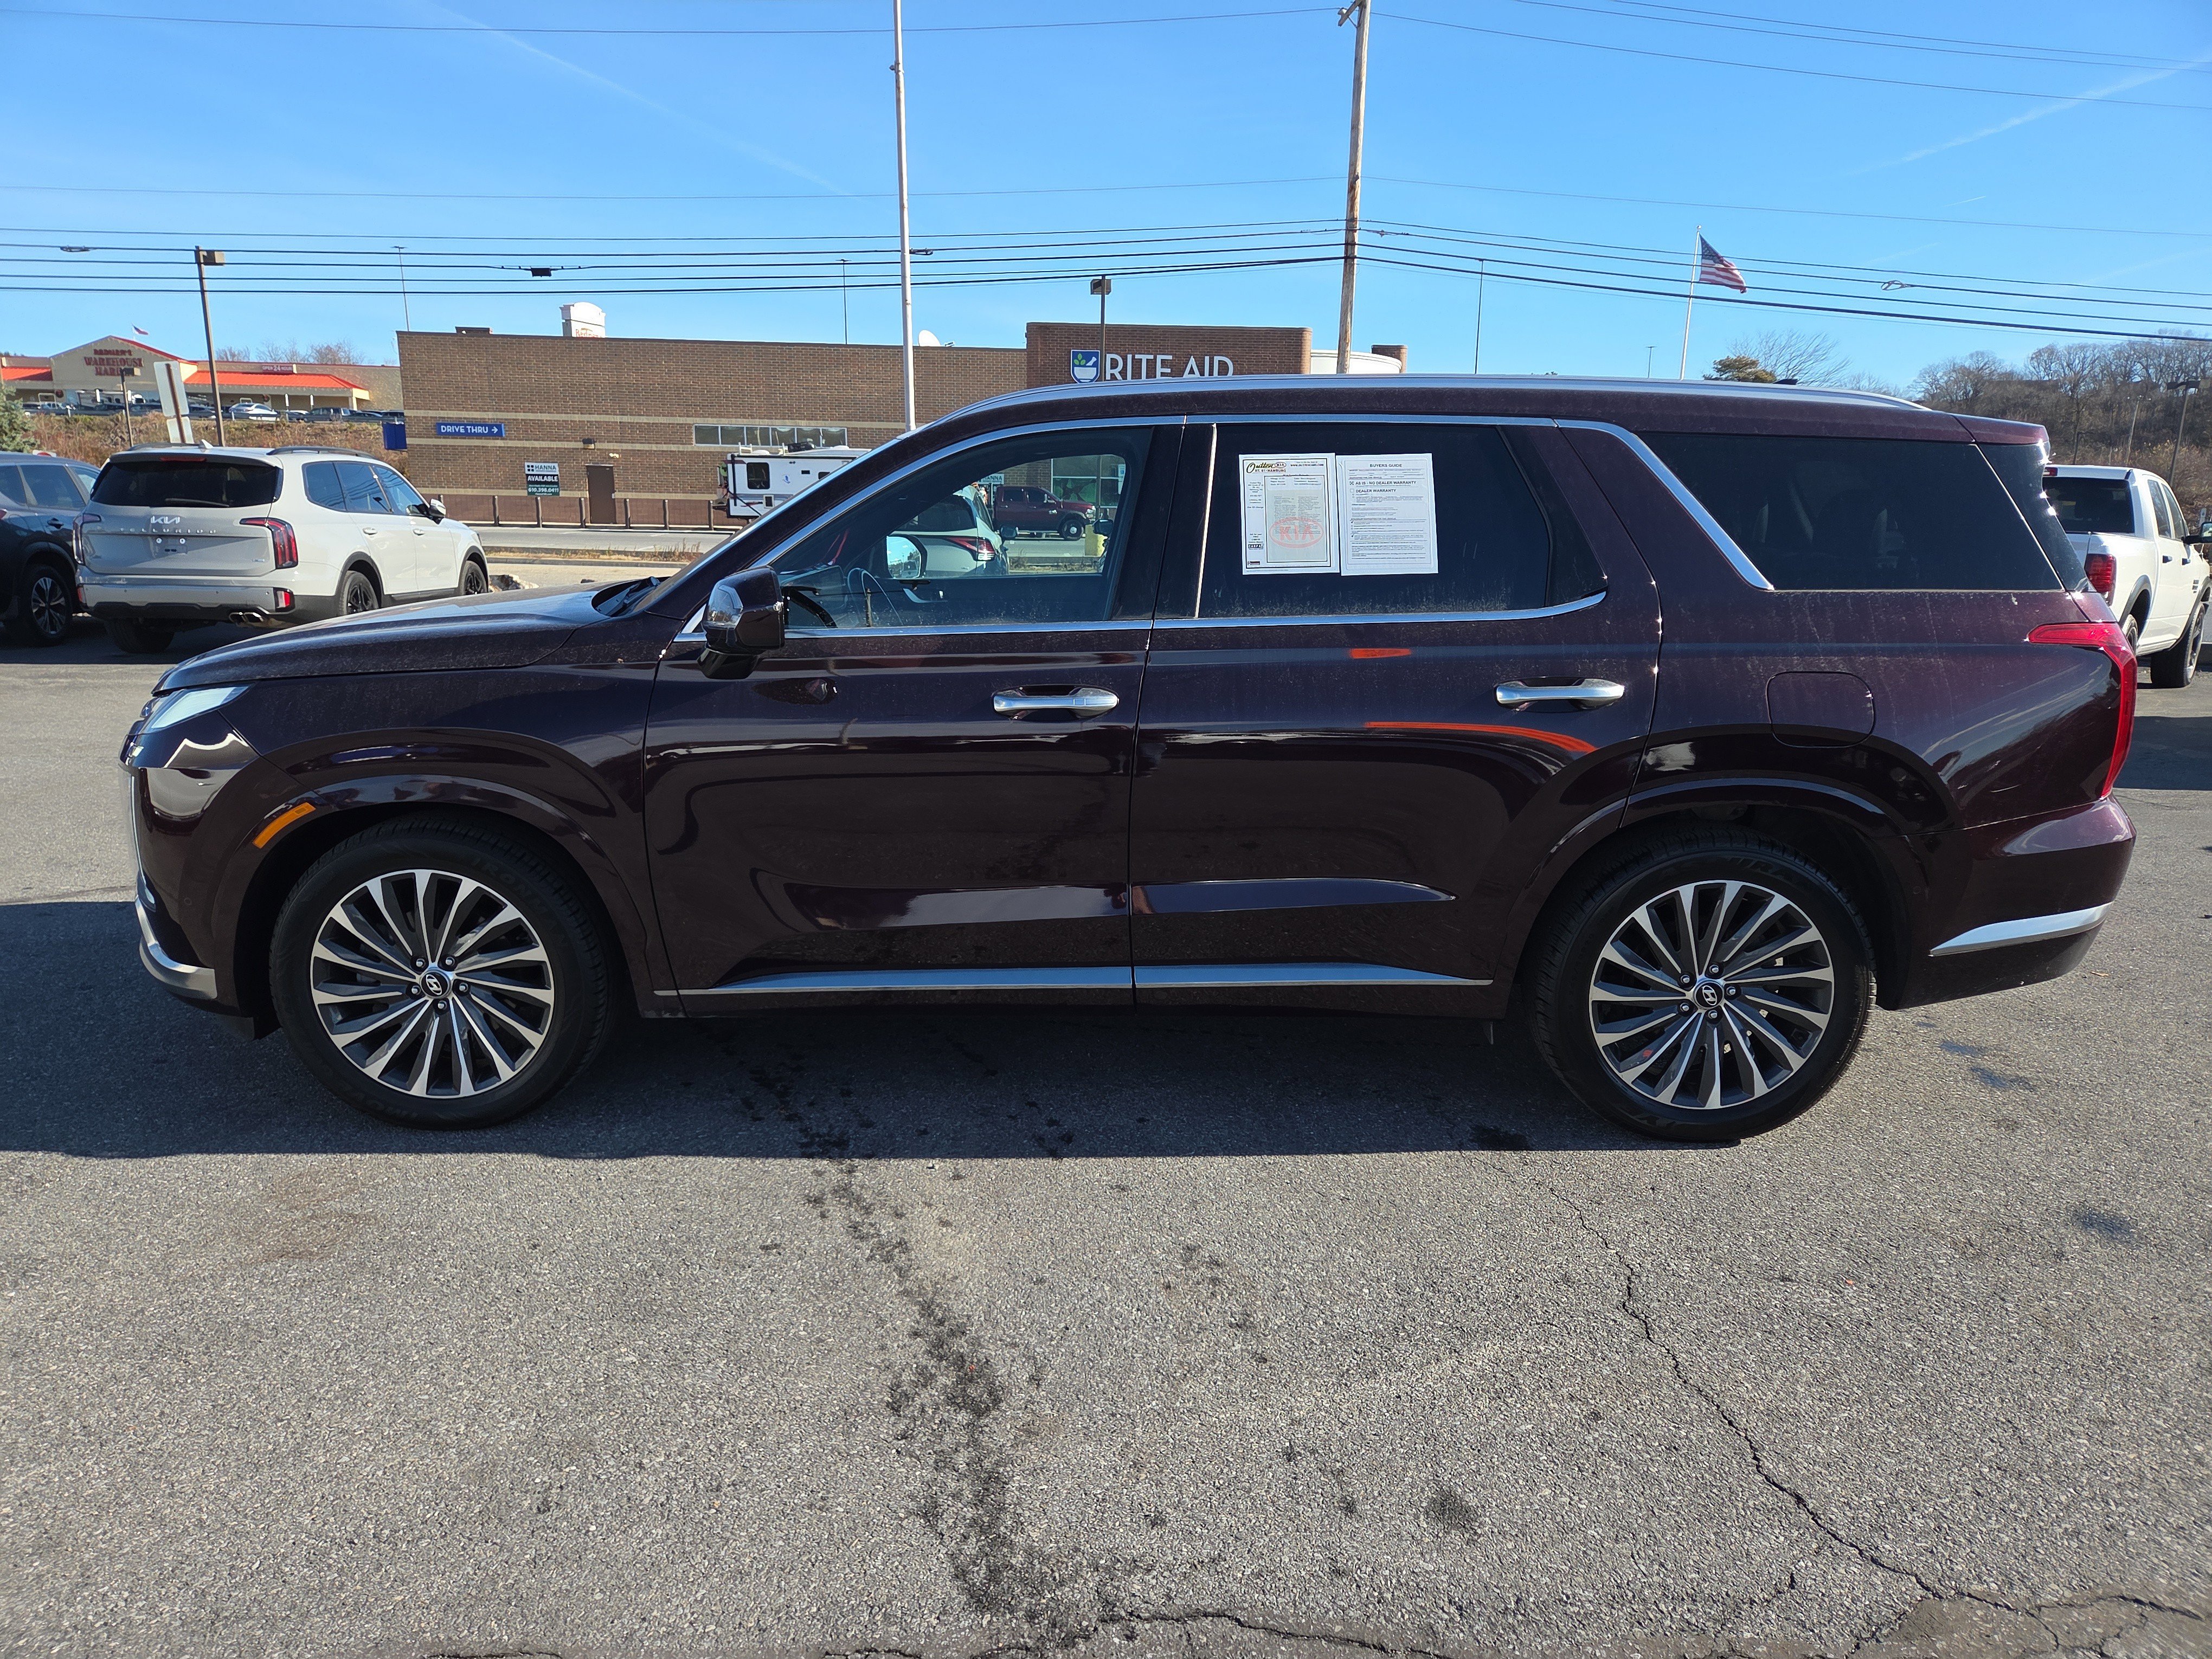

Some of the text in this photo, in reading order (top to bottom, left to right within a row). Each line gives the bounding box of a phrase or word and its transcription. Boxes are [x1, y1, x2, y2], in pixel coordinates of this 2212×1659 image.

[1105, 353, 1234, 380] RITE AID
[1280, 525, 1314, 541] KIA
